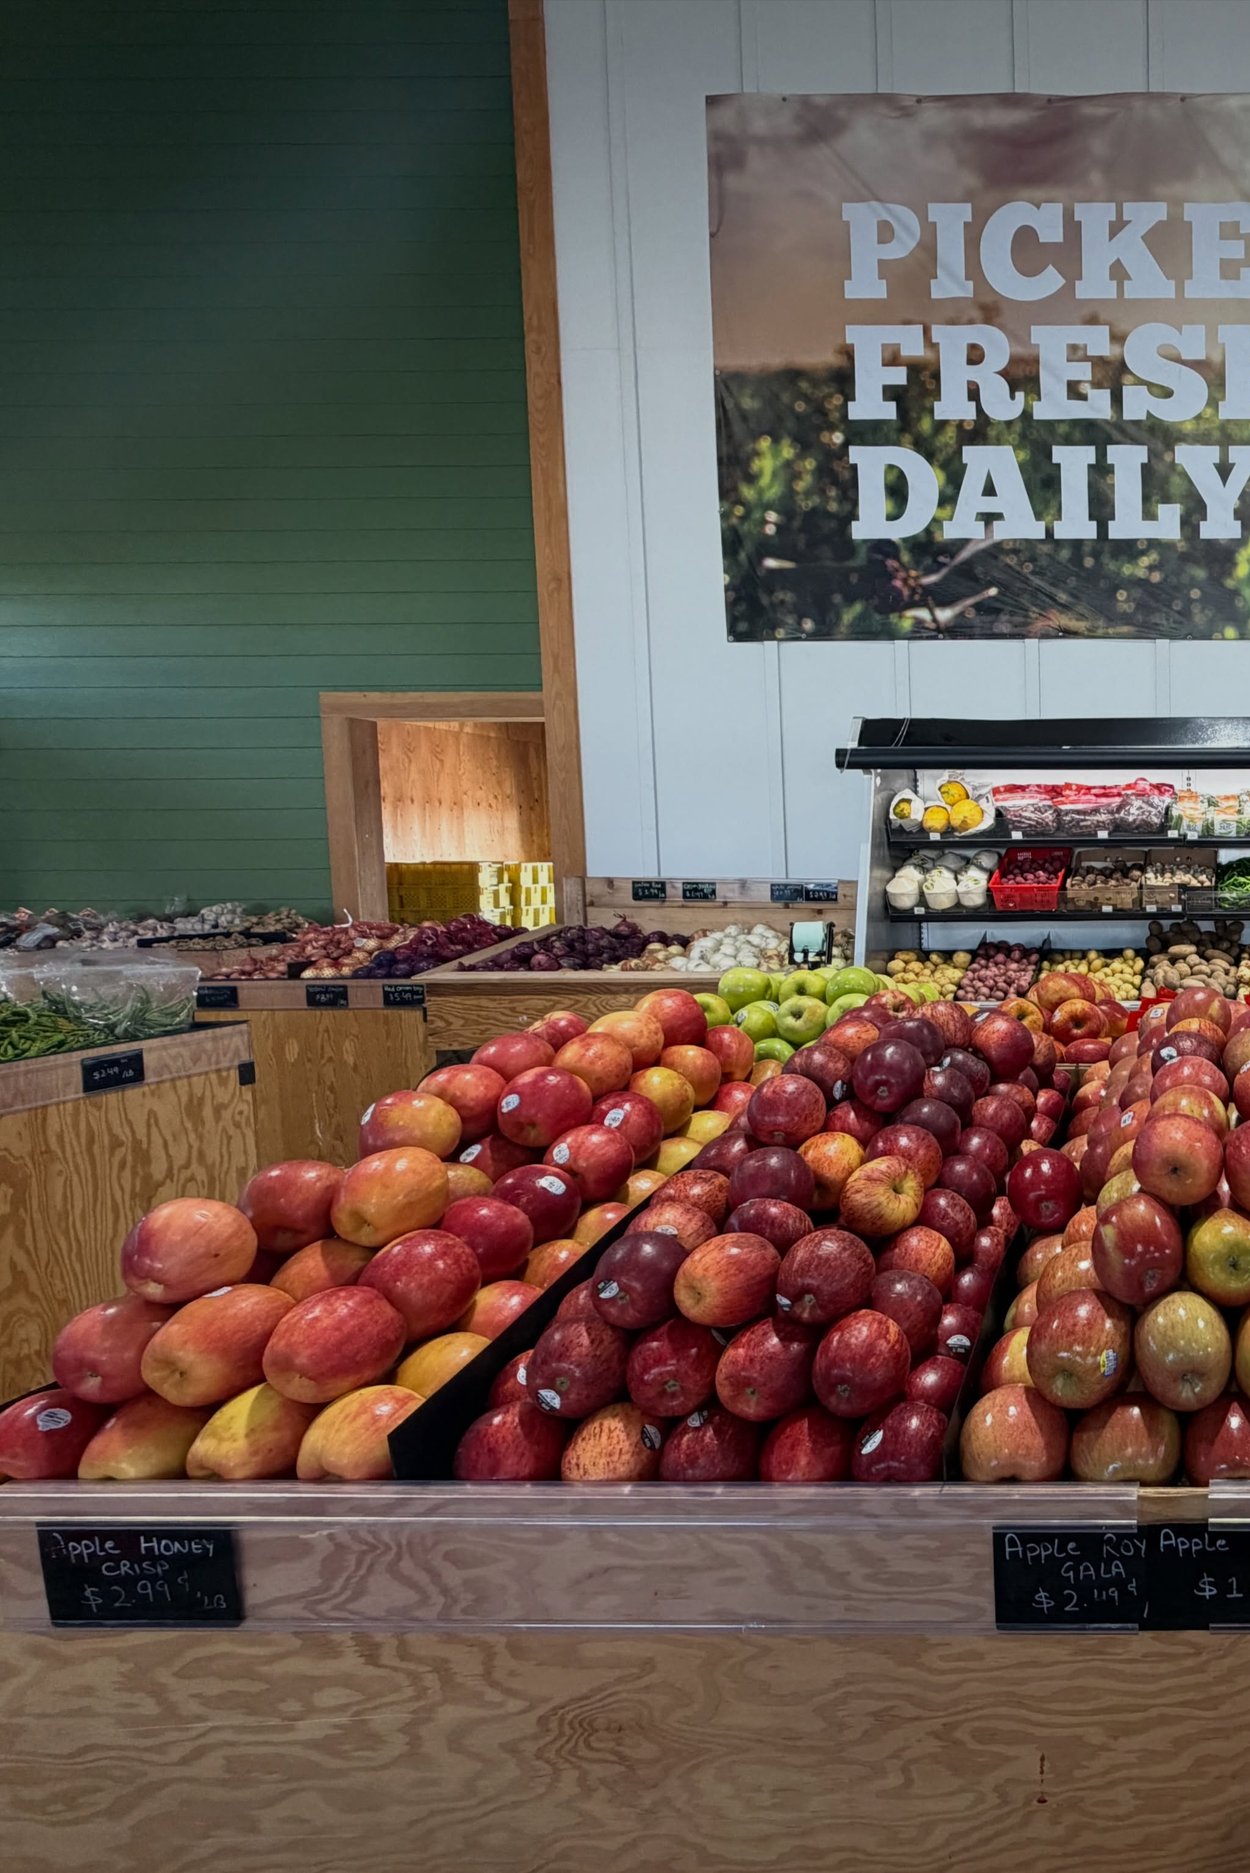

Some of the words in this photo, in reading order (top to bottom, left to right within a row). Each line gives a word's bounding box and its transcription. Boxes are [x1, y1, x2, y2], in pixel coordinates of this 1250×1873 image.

[139, 1535, 214, 1558] HONEY
[1005, 1533, 1081, 1564] Apple
[1160, 1528, 1230, 1558] Apple
[102, 1560, 169, 1577] CRISP
[1060, 1560, 1126, 1584] GALA
